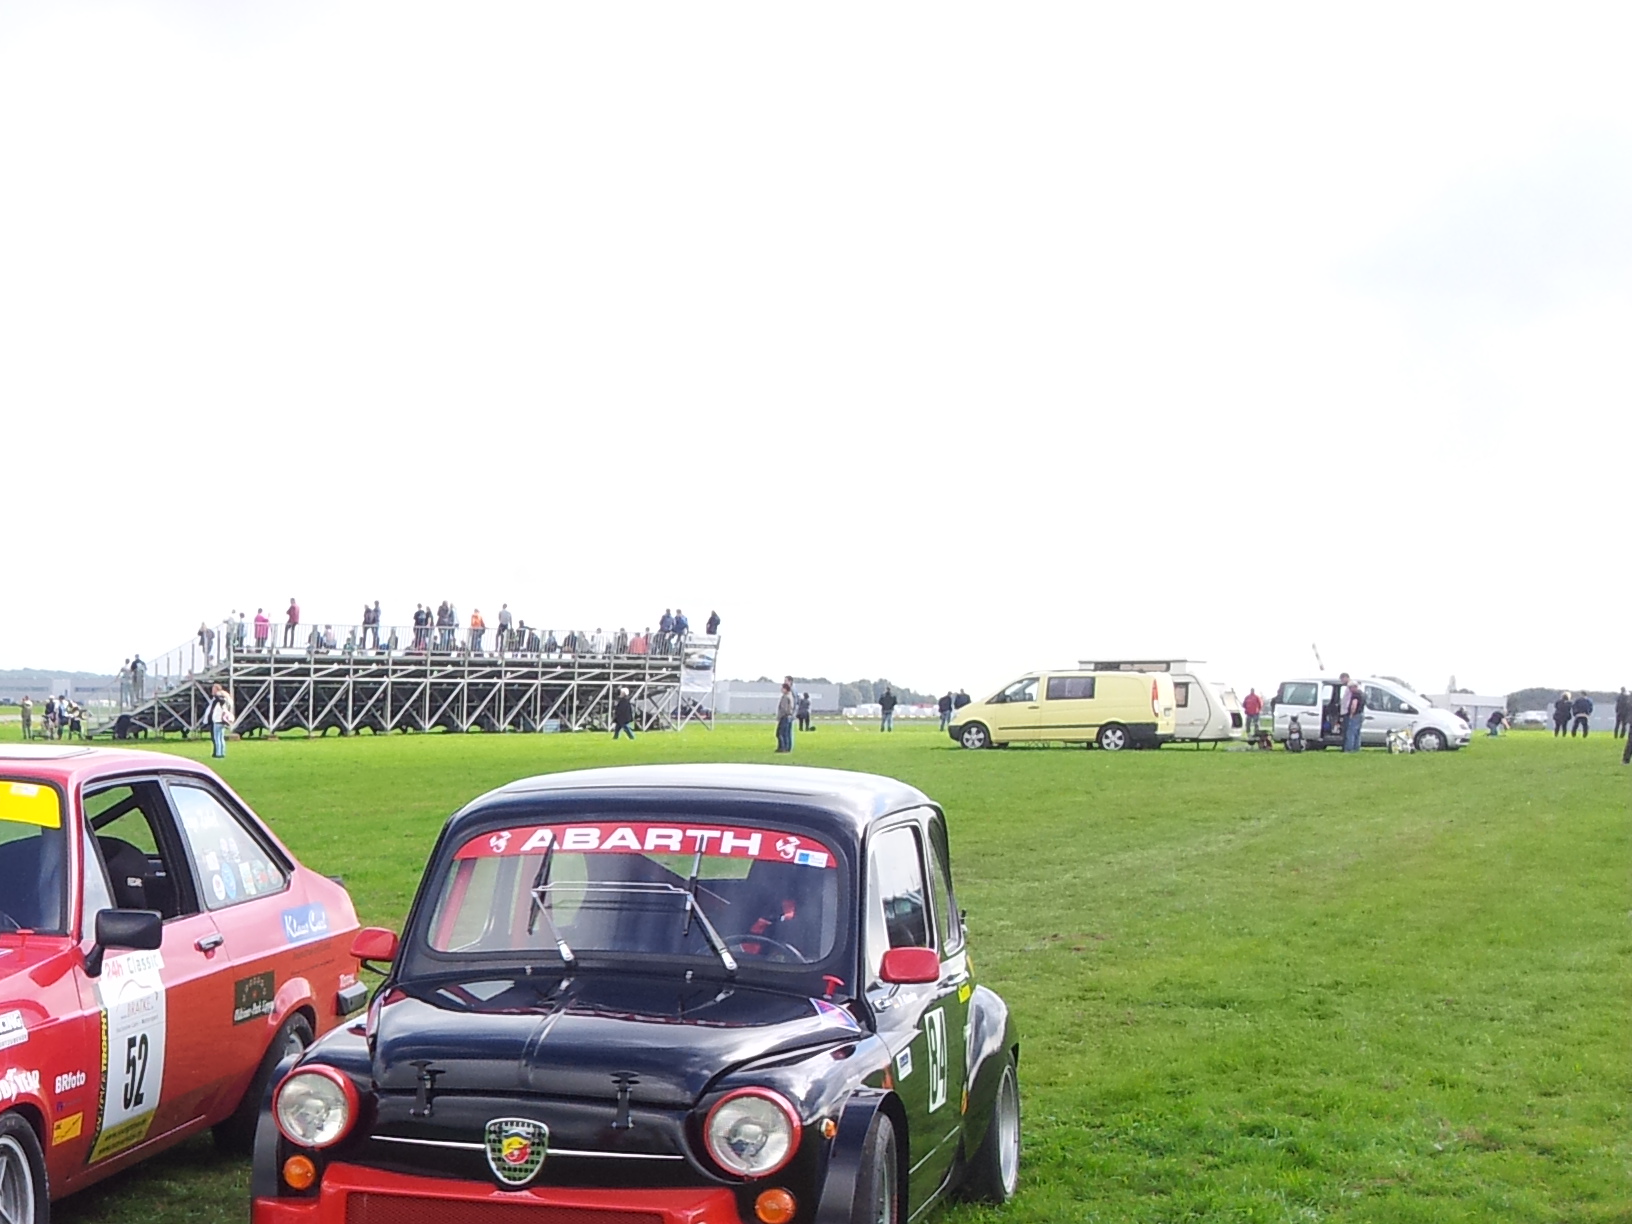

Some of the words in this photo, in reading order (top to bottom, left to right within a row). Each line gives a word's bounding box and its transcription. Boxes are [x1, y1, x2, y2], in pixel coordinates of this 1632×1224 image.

[520, 827, 763, 856] ABARTH
[104, 960, 124, 978] 24h
[127, 955, 159, 974] Classic
[123, 1033, 149, 1110] 52
